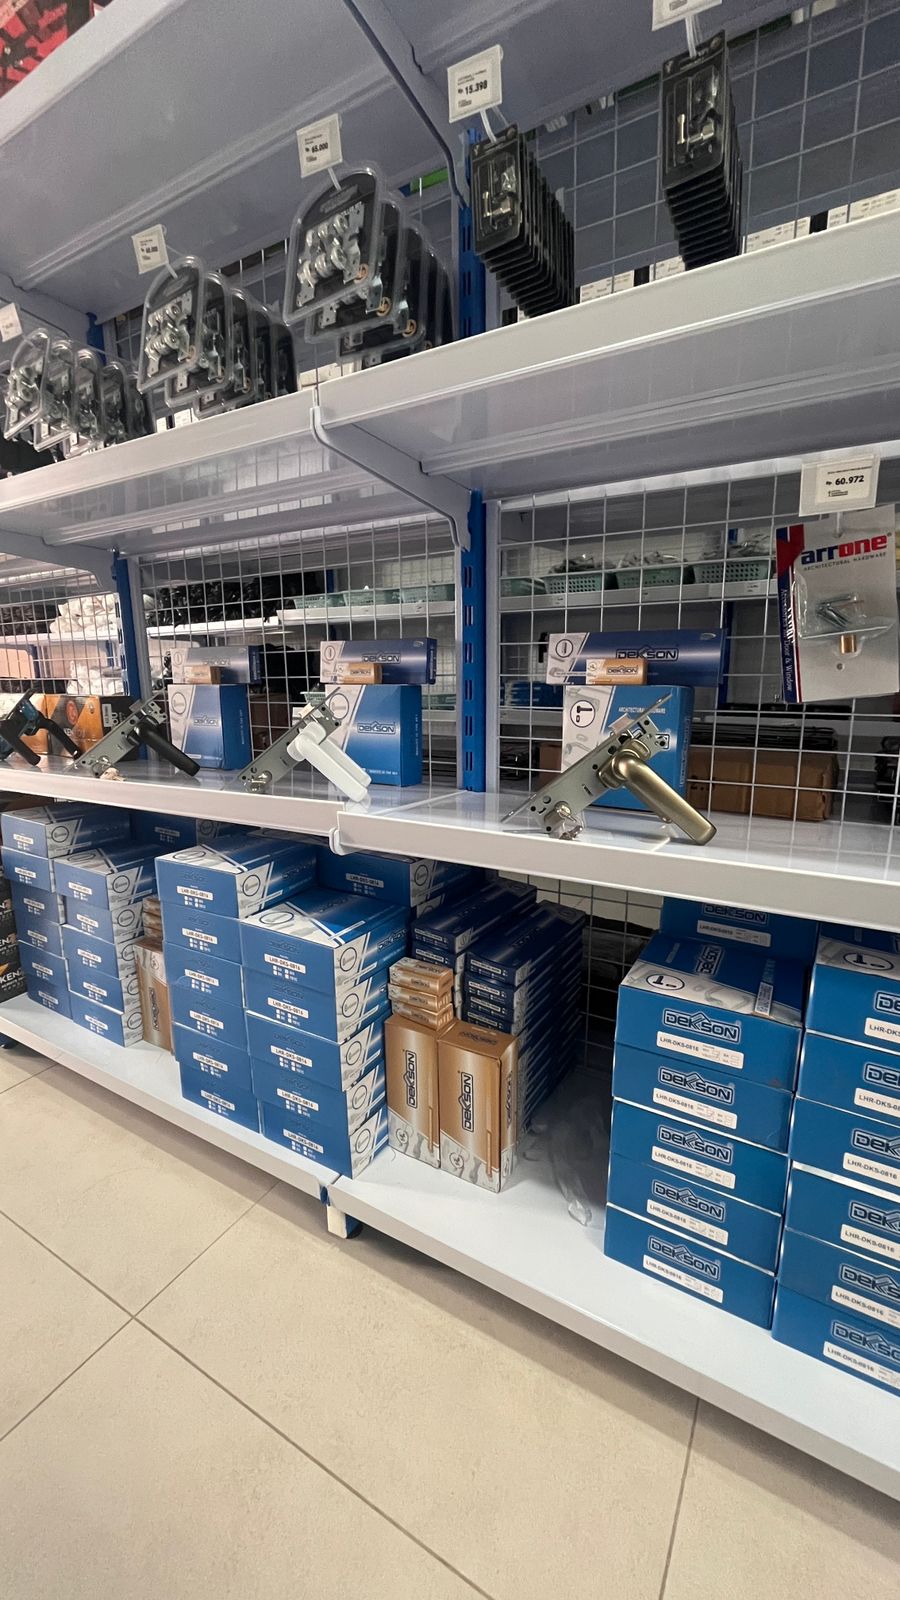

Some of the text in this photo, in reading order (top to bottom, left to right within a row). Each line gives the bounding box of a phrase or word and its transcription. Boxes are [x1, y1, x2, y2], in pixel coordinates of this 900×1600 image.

[835, 475, 865, 486] 60.972
[801, 535, 888, 566] arrone
[803, 552, 887, 572] ARCHITECTURAL HARDWARE
[616, 648, 678, 660] DEKSON
[607, 666, 638, 675] DEKSON
[785, 665, 794, 691] Window
[358, 723, 395, 733] DEKSON
[665, 1012, 738, 1040] DEKSON
[405, 1051, 417, 1107] DEKSON
[661, 1070, 732, 1101] DEKSON
[461, 1073, 473, 1131] DEKSON
[660, 1128, 730, 1161] DEKSON
[847, 1159, 898, 1179] LHR-DKS-0816
[655, 1183, 722, 1218] DEKSON
[844, 1229, 895, 1253] LHR-DKS-0816
[651, 1239, 717, 1277] DEKSON
